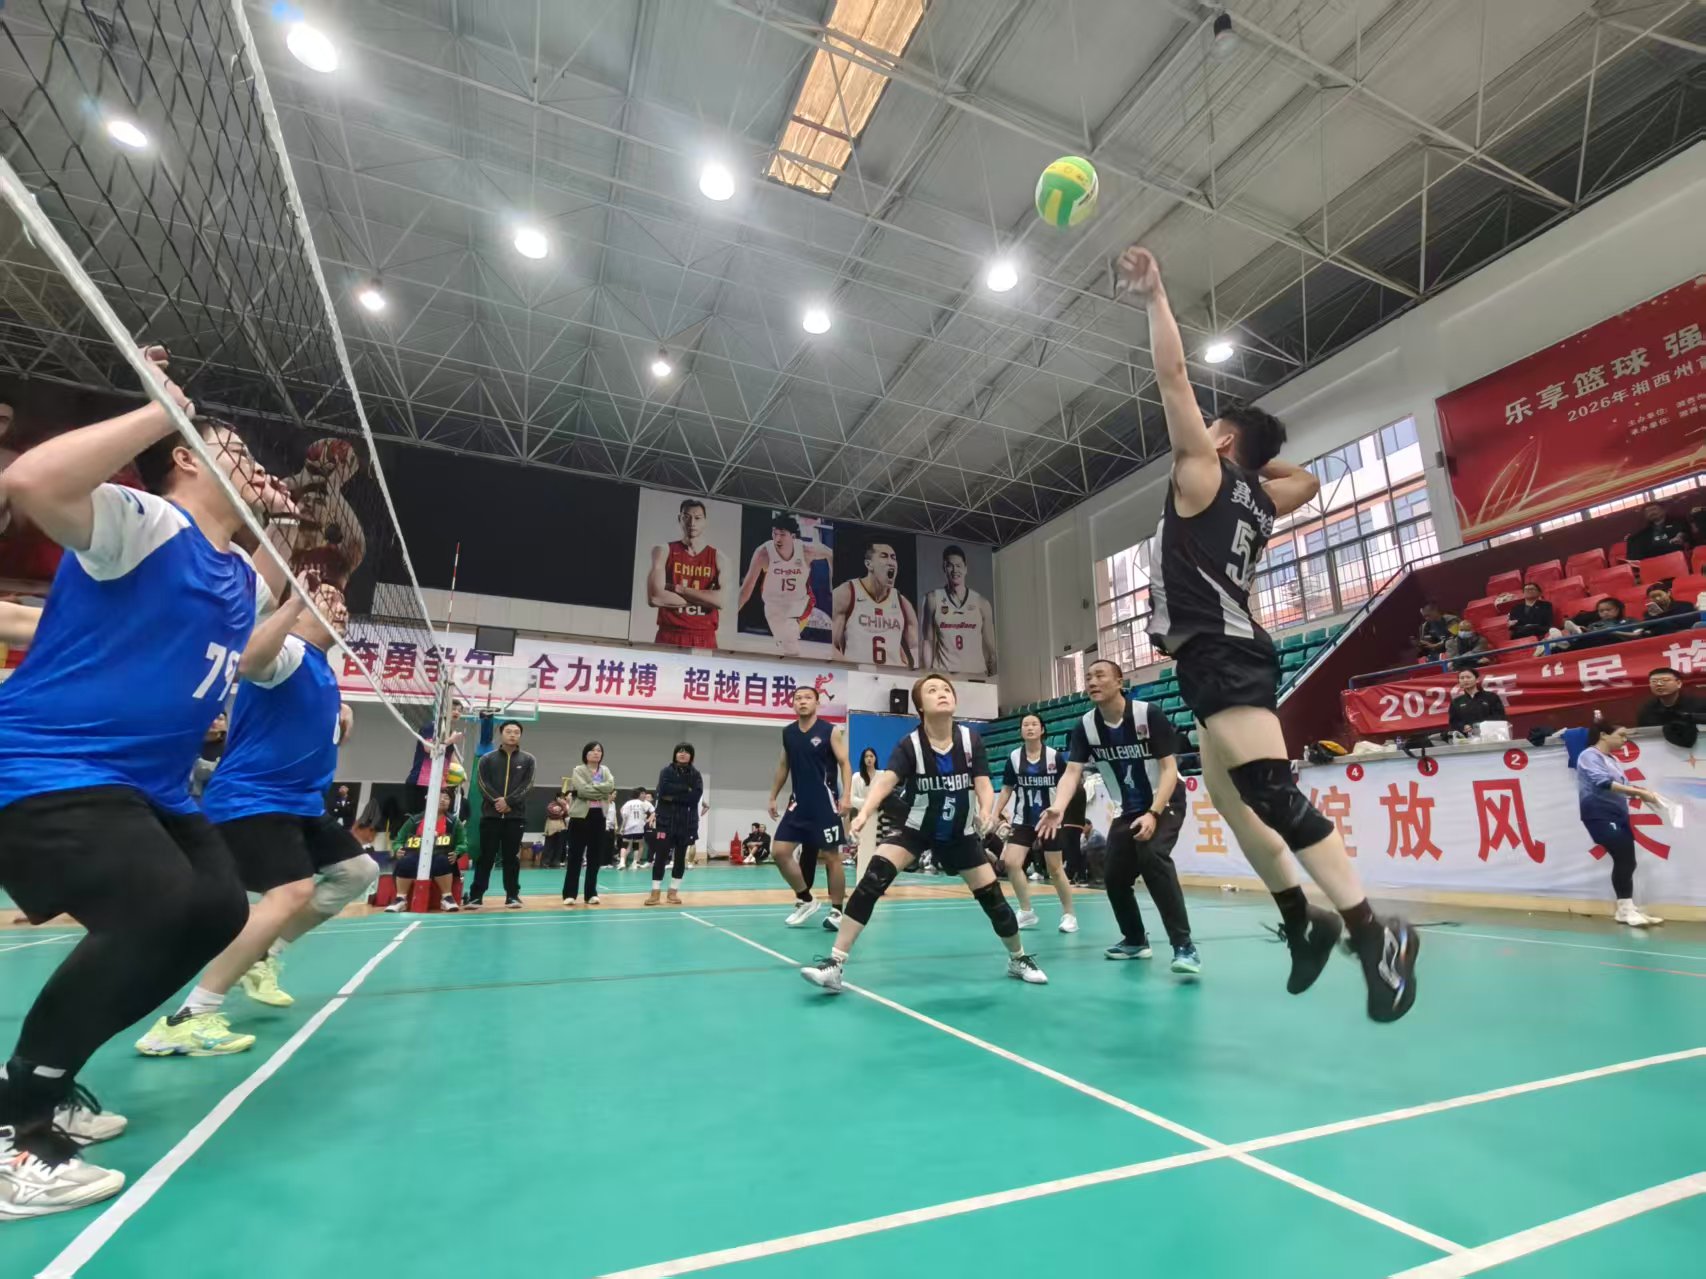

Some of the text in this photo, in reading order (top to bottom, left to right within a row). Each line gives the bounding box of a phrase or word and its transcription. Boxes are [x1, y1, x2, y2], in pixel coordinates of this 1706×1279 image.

[1505, 323, 1706, 425] 乐享篮球 强
[674, 562, 712, 577] CHINA
[773, 568, 802, 576] CHINA
[781, 578, 797, 592] 15
[858, 614, 901, 630] CHINA
[872, 635, 887, 665] 6
[955, 635, 964, 650] 8
[529, 653, 658, 698] 全力拼搏
[683, 666, 797, 708] 超越自我
[1511, 753, 1521, 766] 2
[1124, 764, 1136, 789] 4
[1351, 767, 1360, 777] 4
[1027, 789, 1043, 807] 14
[942, 796, 956, 821] 5
[407, 836, 450, 848] 13 10
[823, 825, 840, 843] 57
